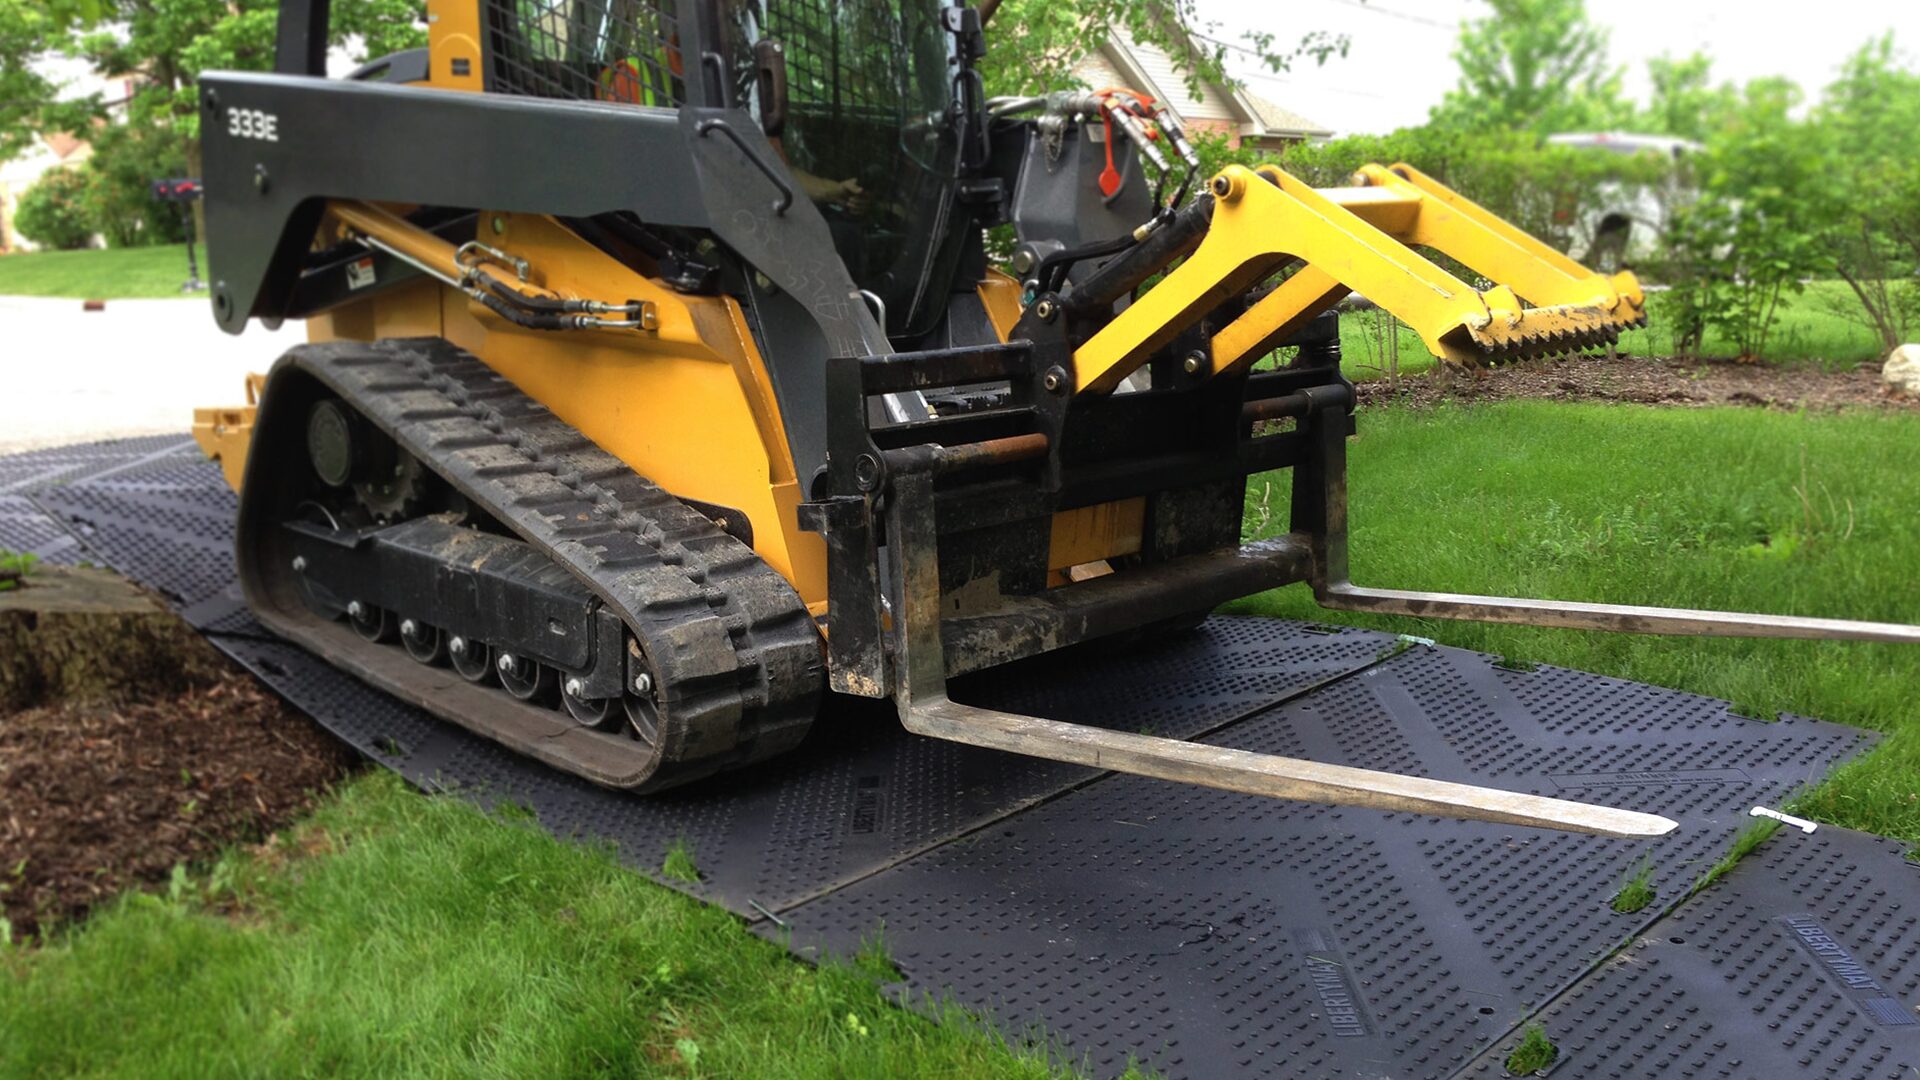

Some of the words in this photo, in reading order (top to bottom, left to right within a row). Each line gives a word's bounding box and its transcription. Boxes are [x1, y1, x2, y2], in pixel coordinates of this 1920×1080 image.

[228, 107, 278, 141] 333E
[1784, 917, 1881, 990] LIBERTYMAT
[1305, 956, 1364, 1037] LIBERTYMAT
